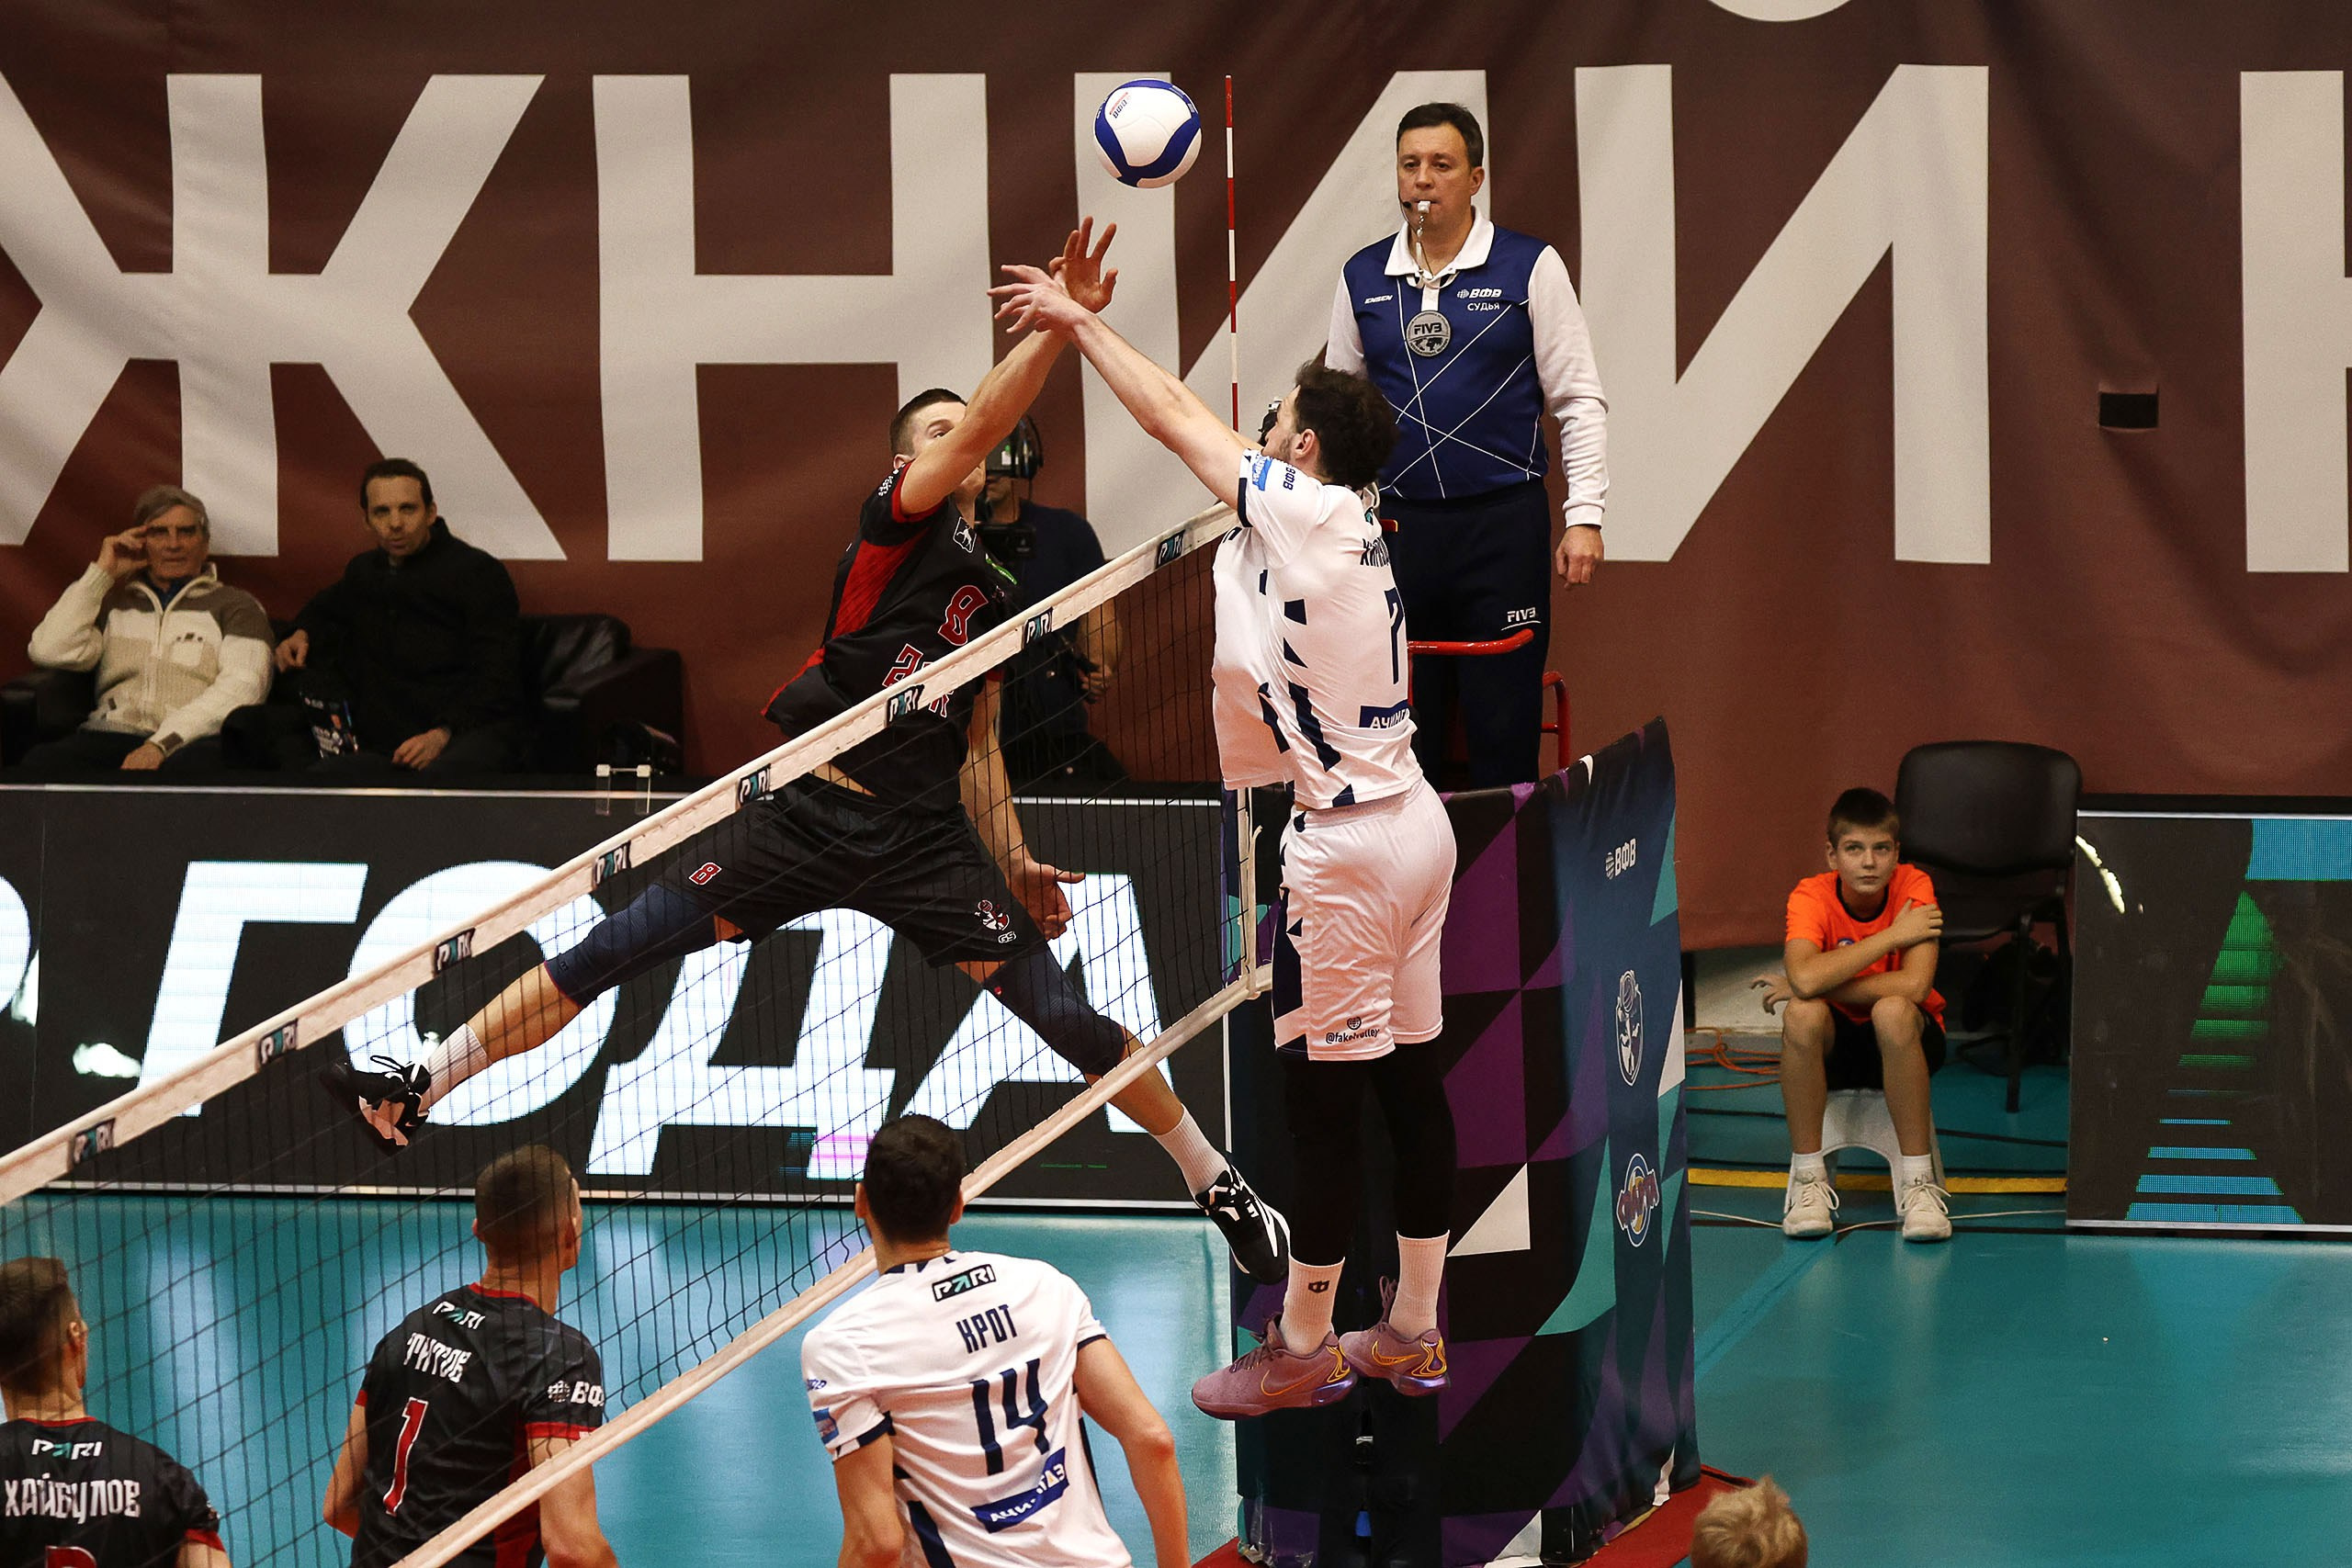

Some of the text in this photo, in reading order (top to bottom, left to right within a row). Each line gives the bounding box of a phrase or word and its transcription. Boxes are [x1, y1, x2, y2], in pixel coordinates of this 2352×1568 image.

[1467, 301, 1500, 311] СУДЬЯ
[1469, 288, 1502, 299] ВФВ
[937, 584, 989, 646] 8
[1370, 708, 1410, 729] АЧИМГ
[688, 862, 722, 886] 8
[1614, 838, 1636, 876] ВФВ
[933, 1265, 996, 1301] PARI
[432, 1301, 485, 1330] PARI
[956, 1303, 1018, 1354] КРОТ
[403, 1332, 472, 1383] ТИТОВ
[570, 1380, 605, 1407] ВФ
[968, 1358, 1050, 1477] 14
[31, 1438, 103, 1461] PARI
[382, 1396, 429, 1516] 1
[4, 1472, 141, 1525] ХАЙБУЛОВ
[989, 1462, 1066, 1523] АЧИГАЗ
